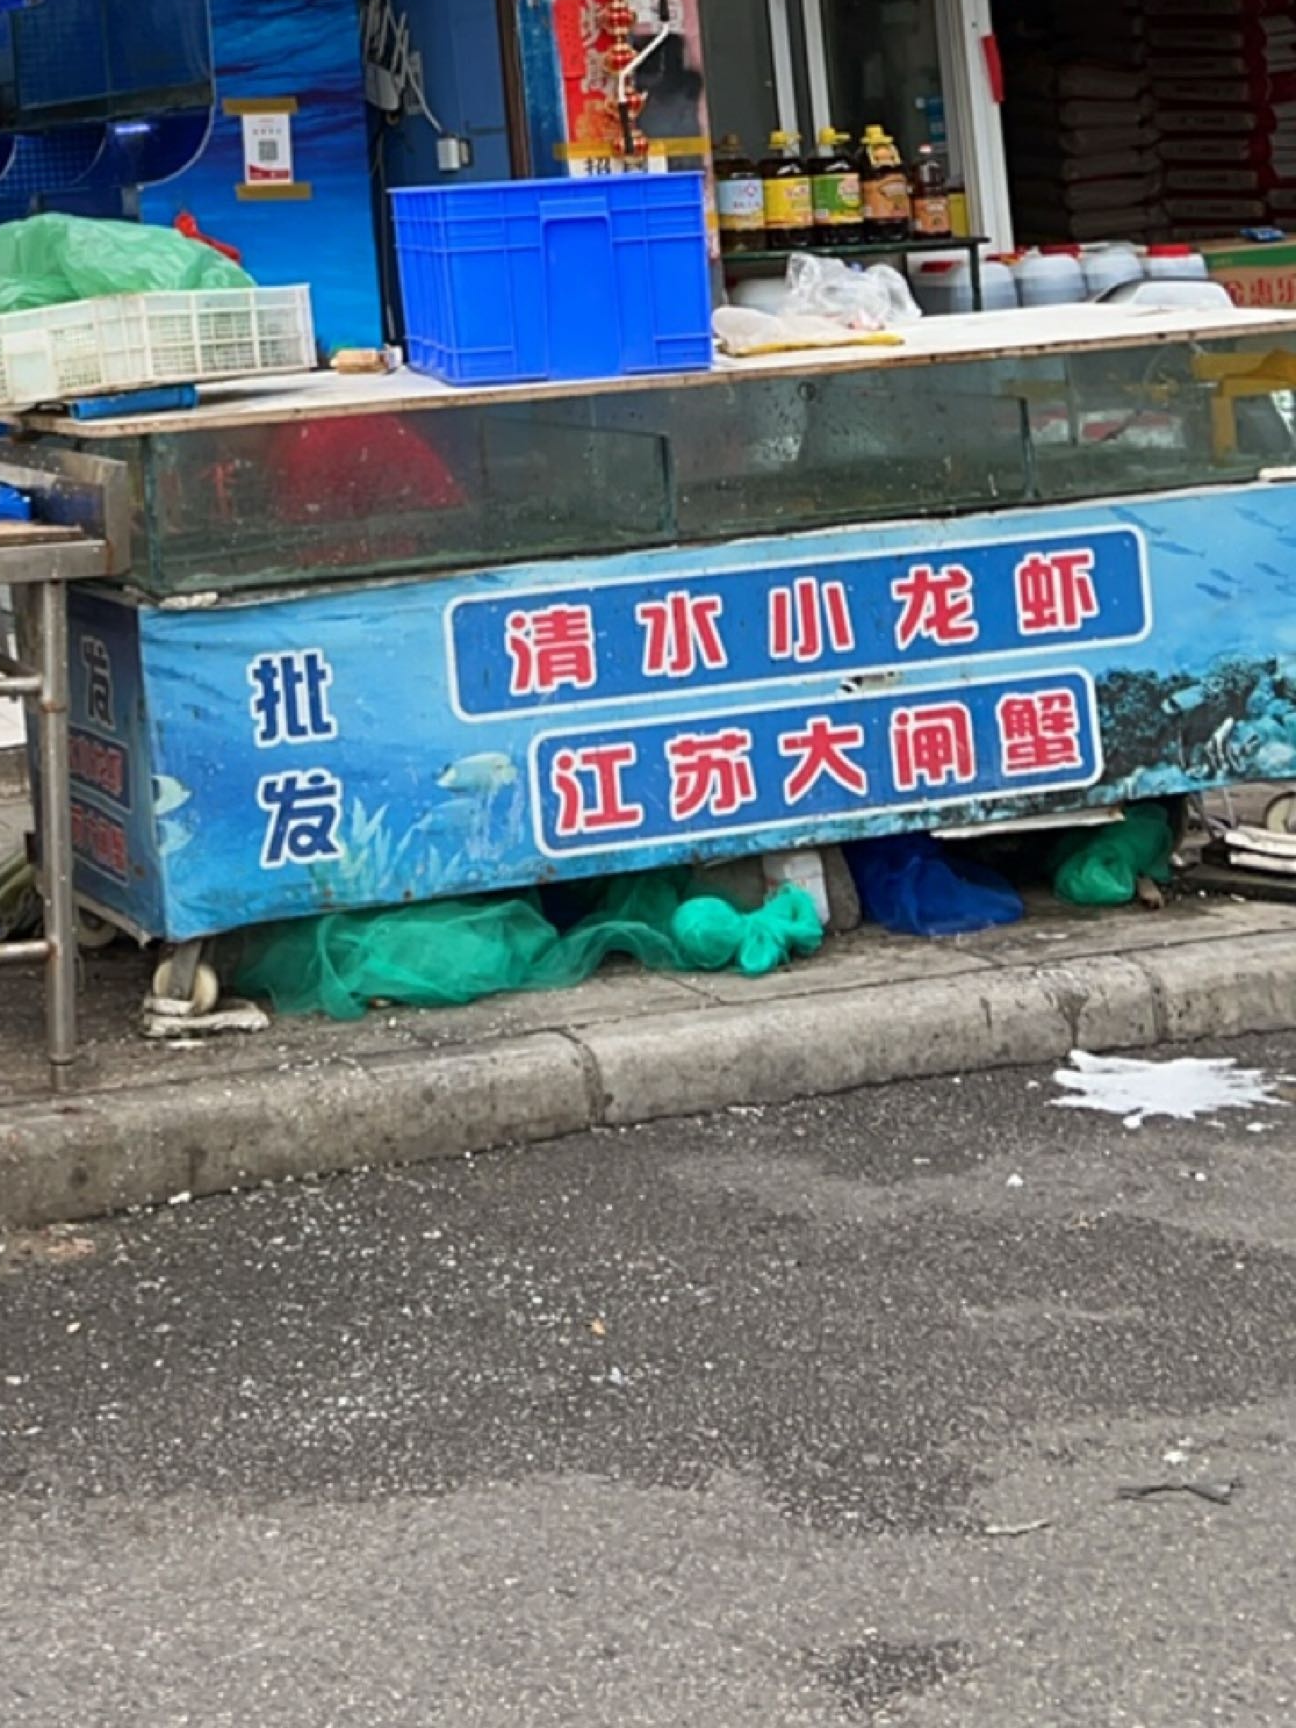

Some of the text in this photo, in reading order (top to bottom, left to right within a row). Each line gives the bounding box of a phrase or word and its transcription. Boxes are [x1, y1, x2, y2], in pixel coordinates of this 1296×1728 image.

[503, 546, 1101, 698] 清水小龙虾
[247, 649, 341, 866] 批发
[549, 690, 1084, 836] 江苏大闸蟹
